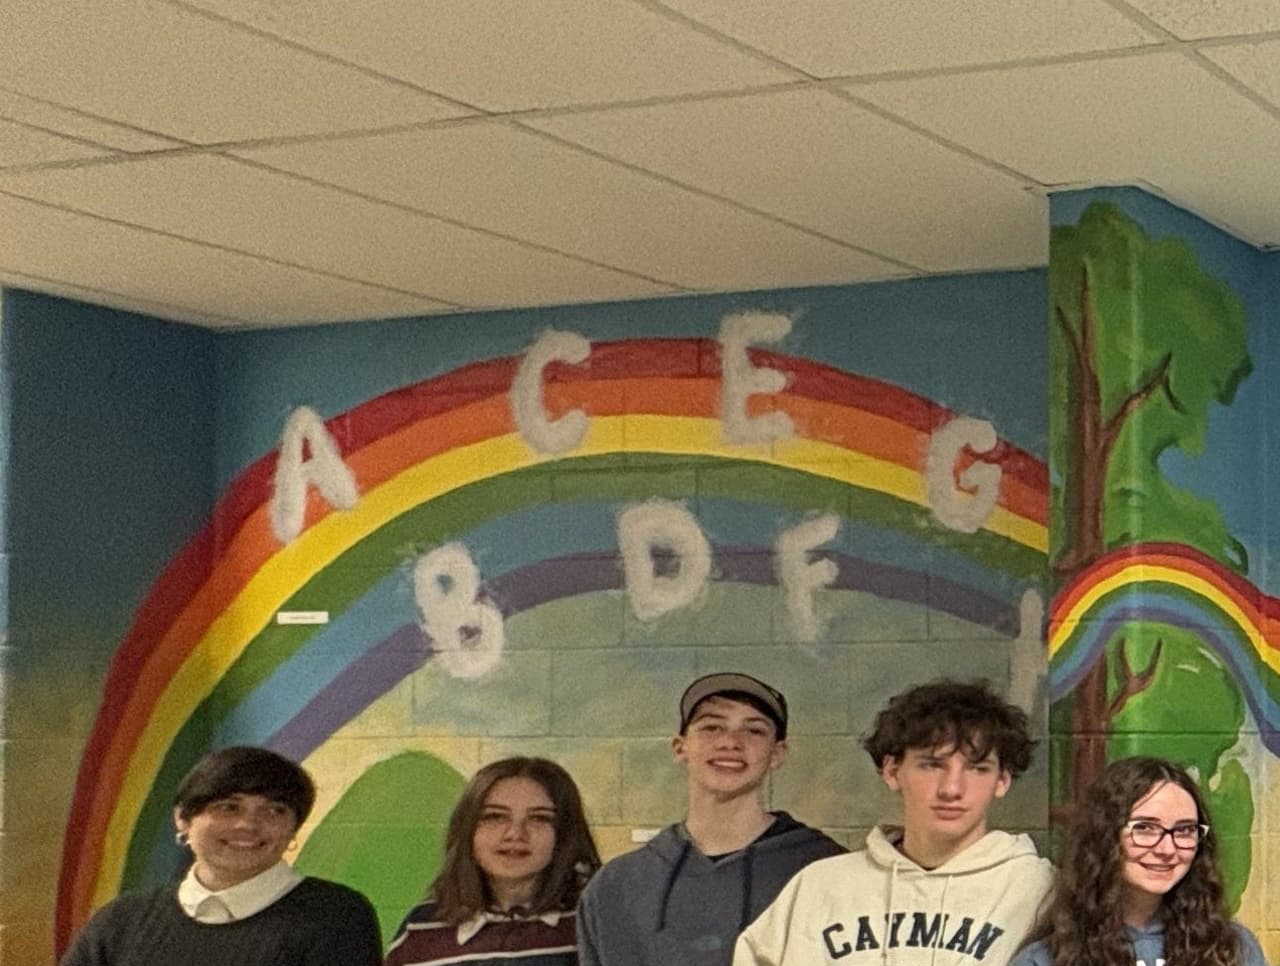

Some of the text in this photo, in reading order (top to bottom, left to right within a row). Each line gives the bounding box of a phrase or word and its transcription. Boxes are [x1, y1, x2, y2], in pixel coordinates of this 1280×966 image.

[270, 310, 1006, 545] A C E G
[411, 500, 845, 680] B D F
[822, 911, 1005, 961] CAYMAN
